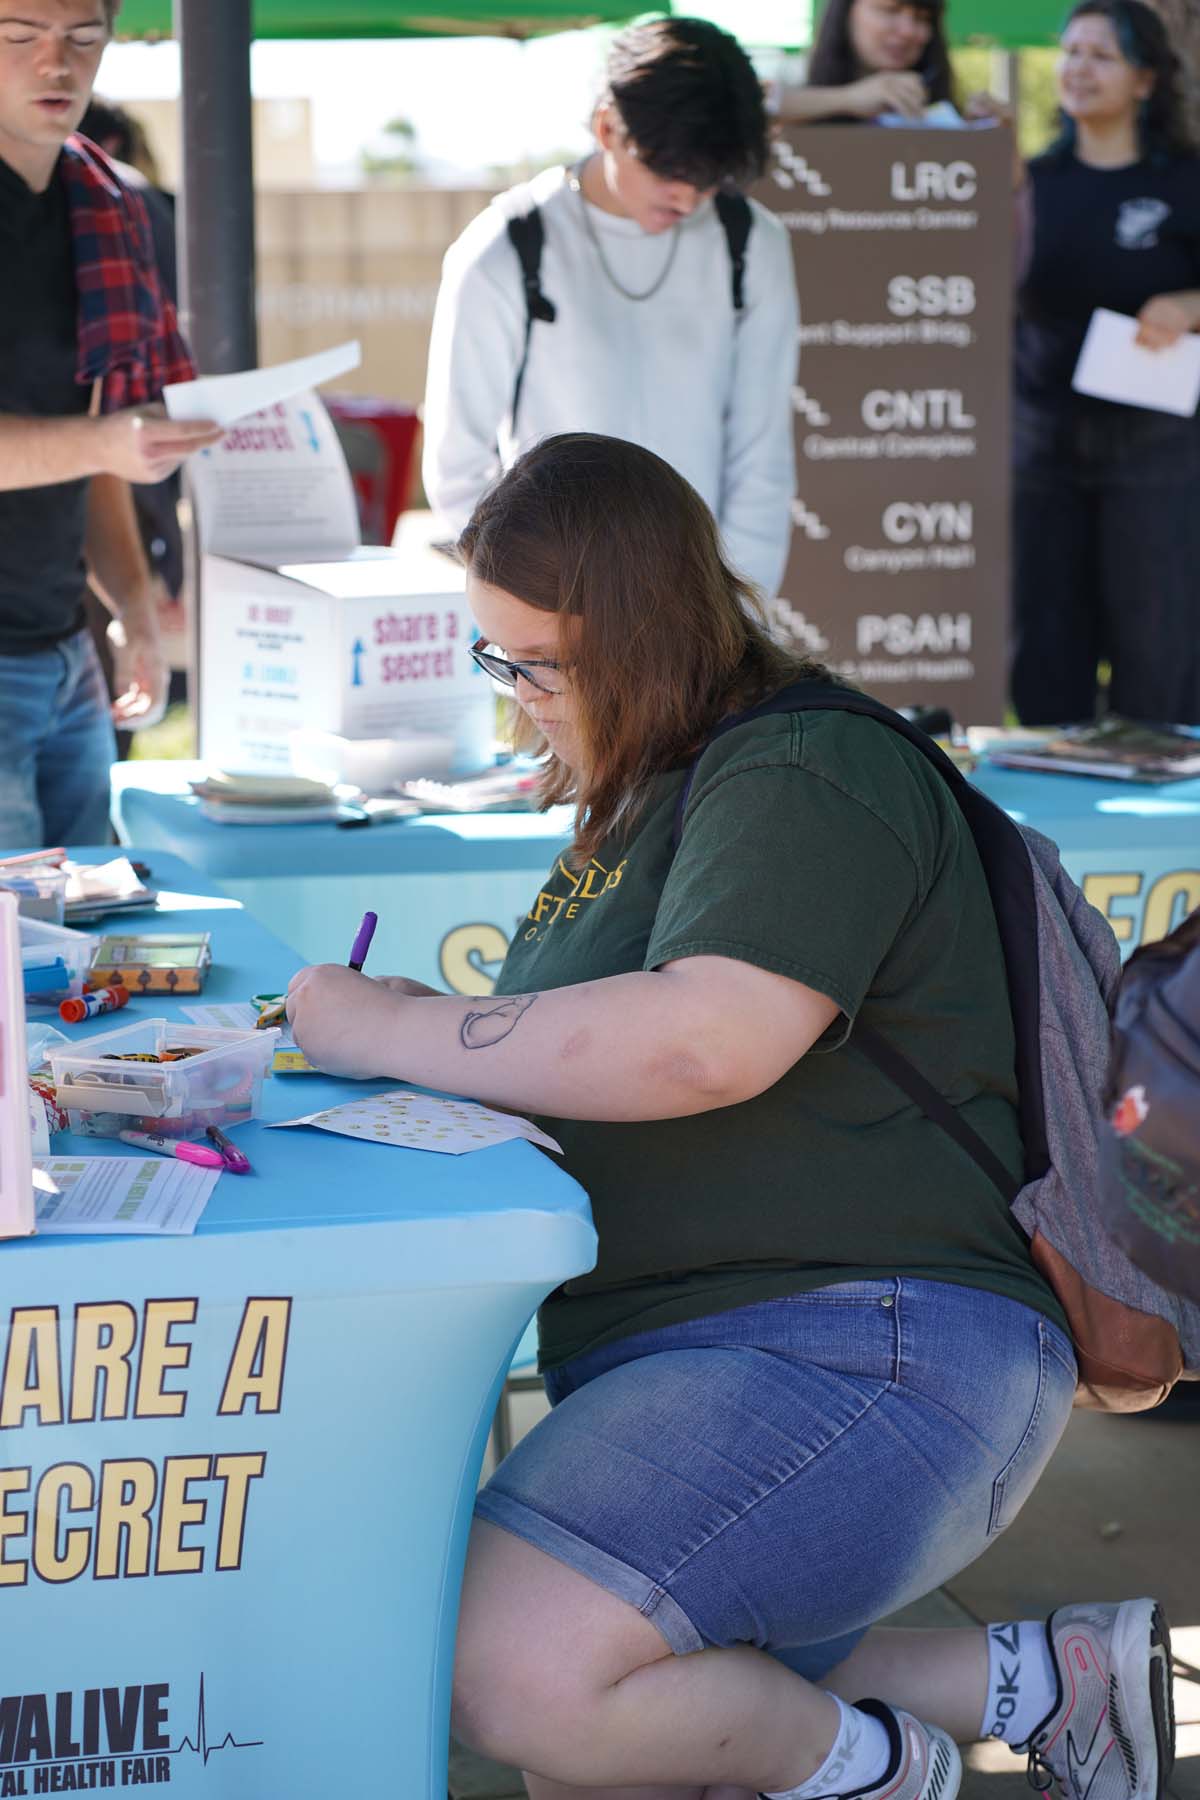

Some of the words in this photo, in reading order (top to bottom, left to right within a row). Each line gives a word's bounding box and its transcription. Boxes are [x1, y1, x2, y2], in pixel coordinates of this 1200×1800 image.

[891, 161, 977, 201] LRC
[913, 208, 977, 230] Center
[888, 275, 976, 316] SSB
[831, 320, 913, 348] Support
[861, 389, 976, 431] CNTL
[803, 434, 880, 460] Central
[882, 501, 973, 544] CYN
[373, 611, 440, 645] share
[446, 609, 459, 641] a
[857, 613, 972, 655] PSAH
[381, 645, 455, 684] secret
[0, 1297, 199, 1430] ARE
[217, 1296, 292, 1416] A
[0, 1451, 267, 1588] ECRET
[34, 1761, 116, 1794] HEALTH
[122, 1756, 171, 1786] FAIR
